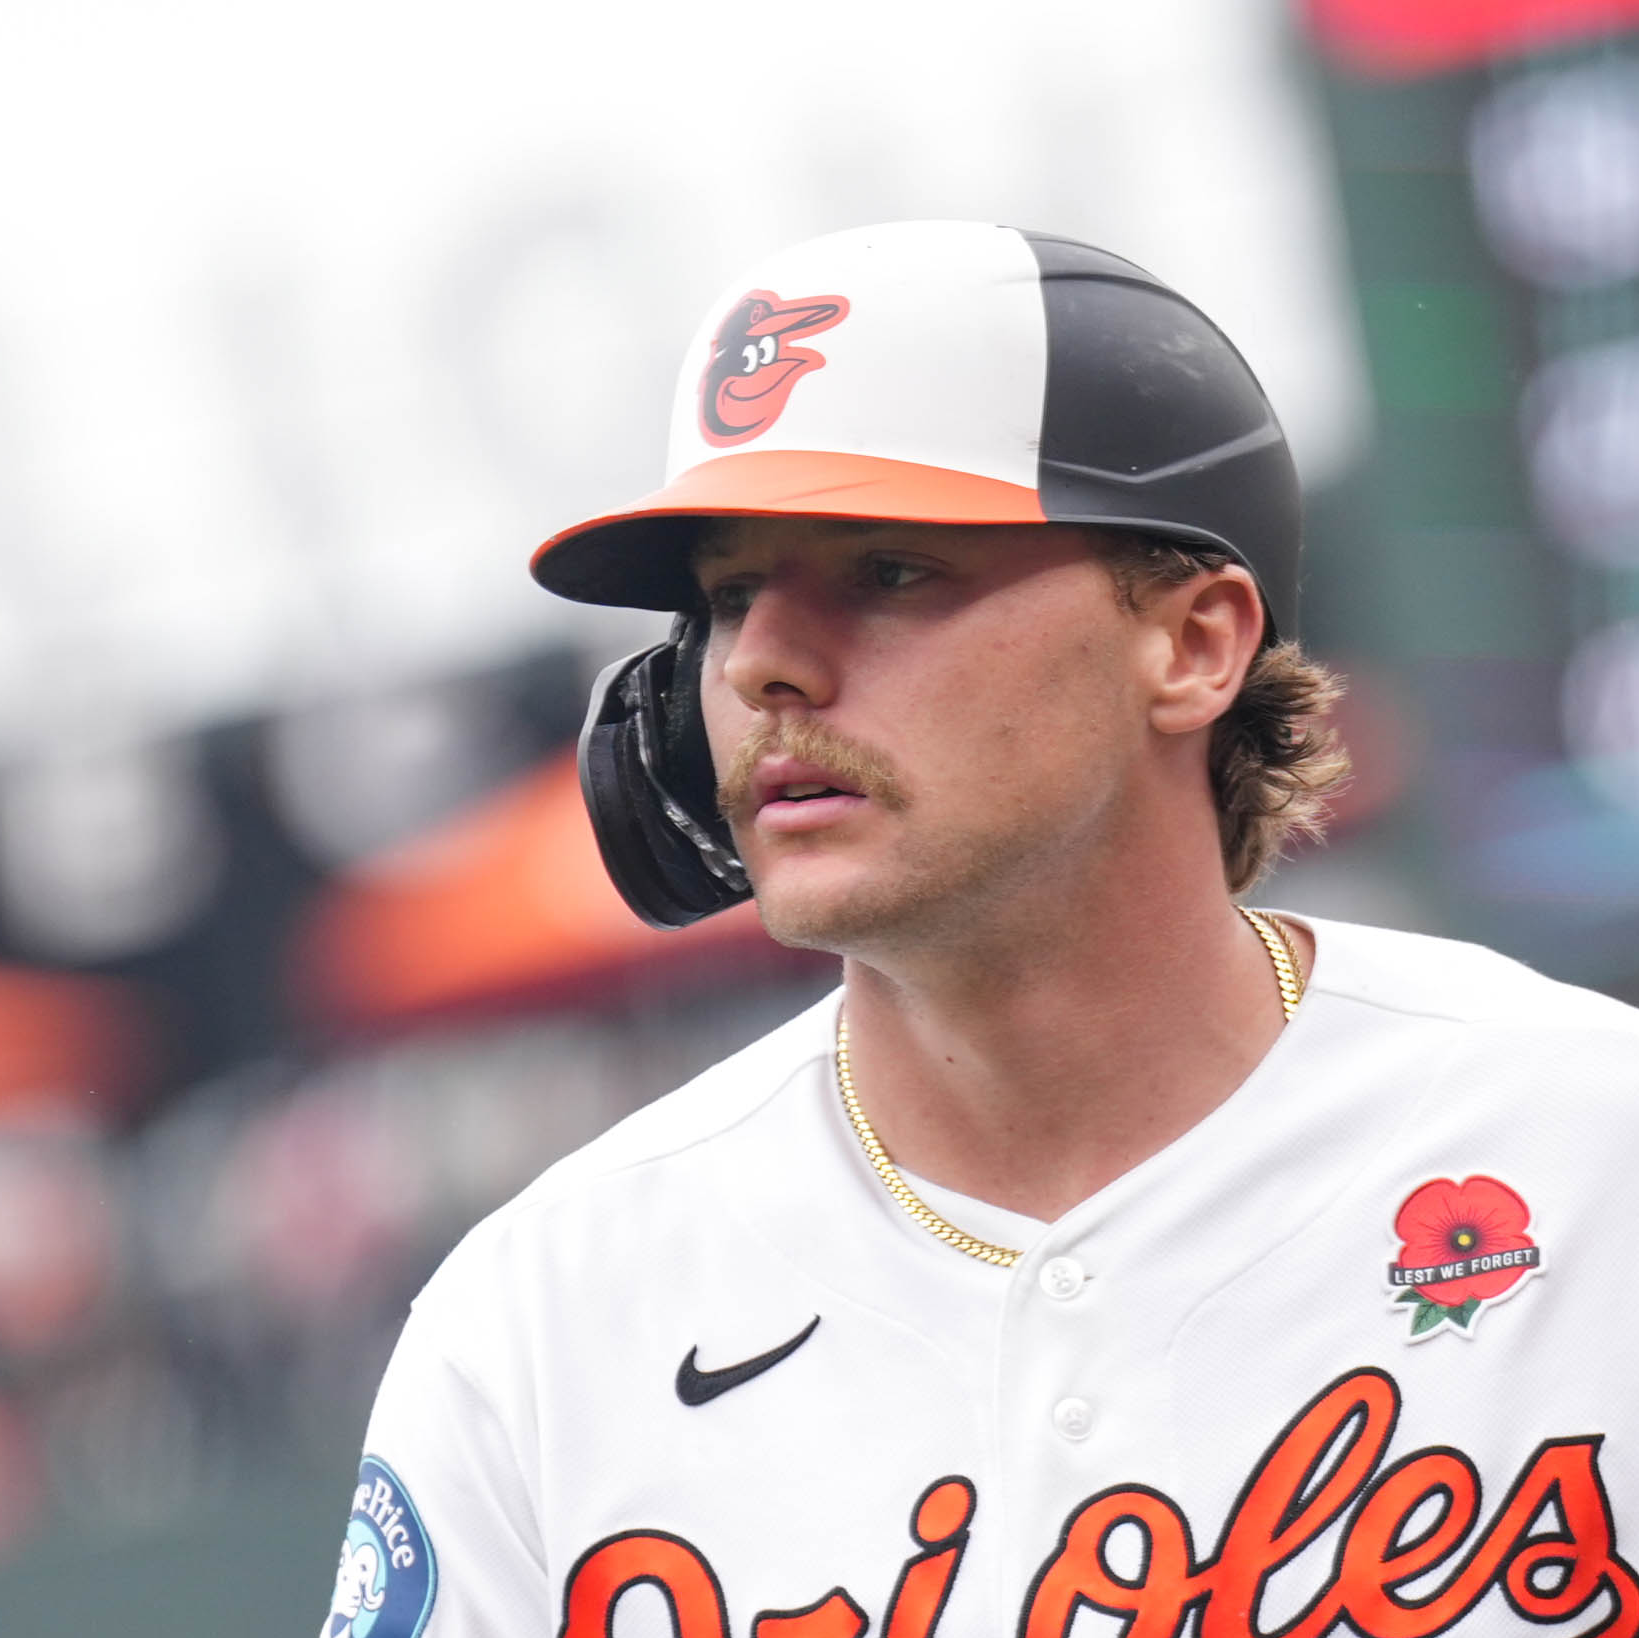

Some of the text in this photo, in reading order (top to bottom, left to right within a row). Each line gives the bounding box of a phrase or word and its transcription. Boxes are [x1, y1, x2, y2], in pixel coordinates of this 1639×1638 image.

[1394, 1249, 1533, 1285] LEST WE FORGET
